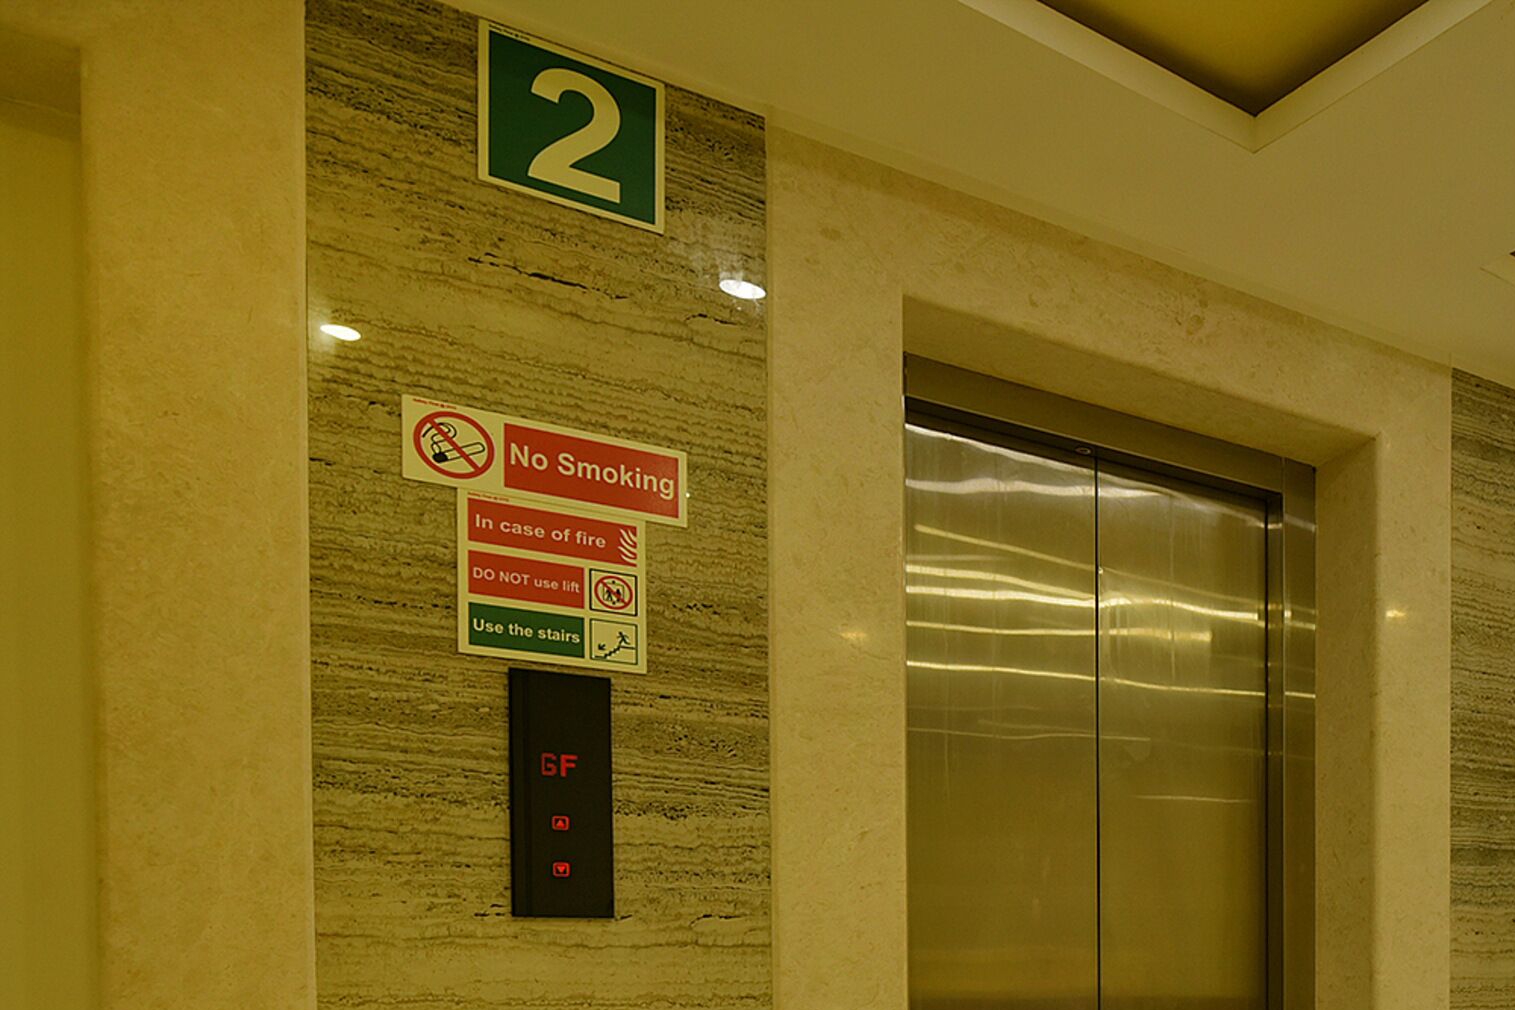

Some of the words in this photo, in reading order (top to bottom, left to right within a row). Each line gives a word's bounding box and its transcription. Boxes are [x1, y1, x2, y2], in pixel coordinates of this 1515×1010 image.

[527, 67, 621, 203] 2
[510, 443, 548, 470] No
[558, 453, 674, 500] Smoking
[475, 514, 493, 529] In
[500, 521, 545, 538] case
[551, 528, 571, 542] of
[576, 531, 606, 548] fire
[473, 567, 495, 581] DO
[499, 571, 530, 585] NOT
[534, 579, 559, 590] use
[562, 581, 580, 593] lift
[473, 618, 504, 633] Use
[509, 624, 533, 638] the
[537, 628, 580, 643] stairs
[540, 753, 578, 777] GF
